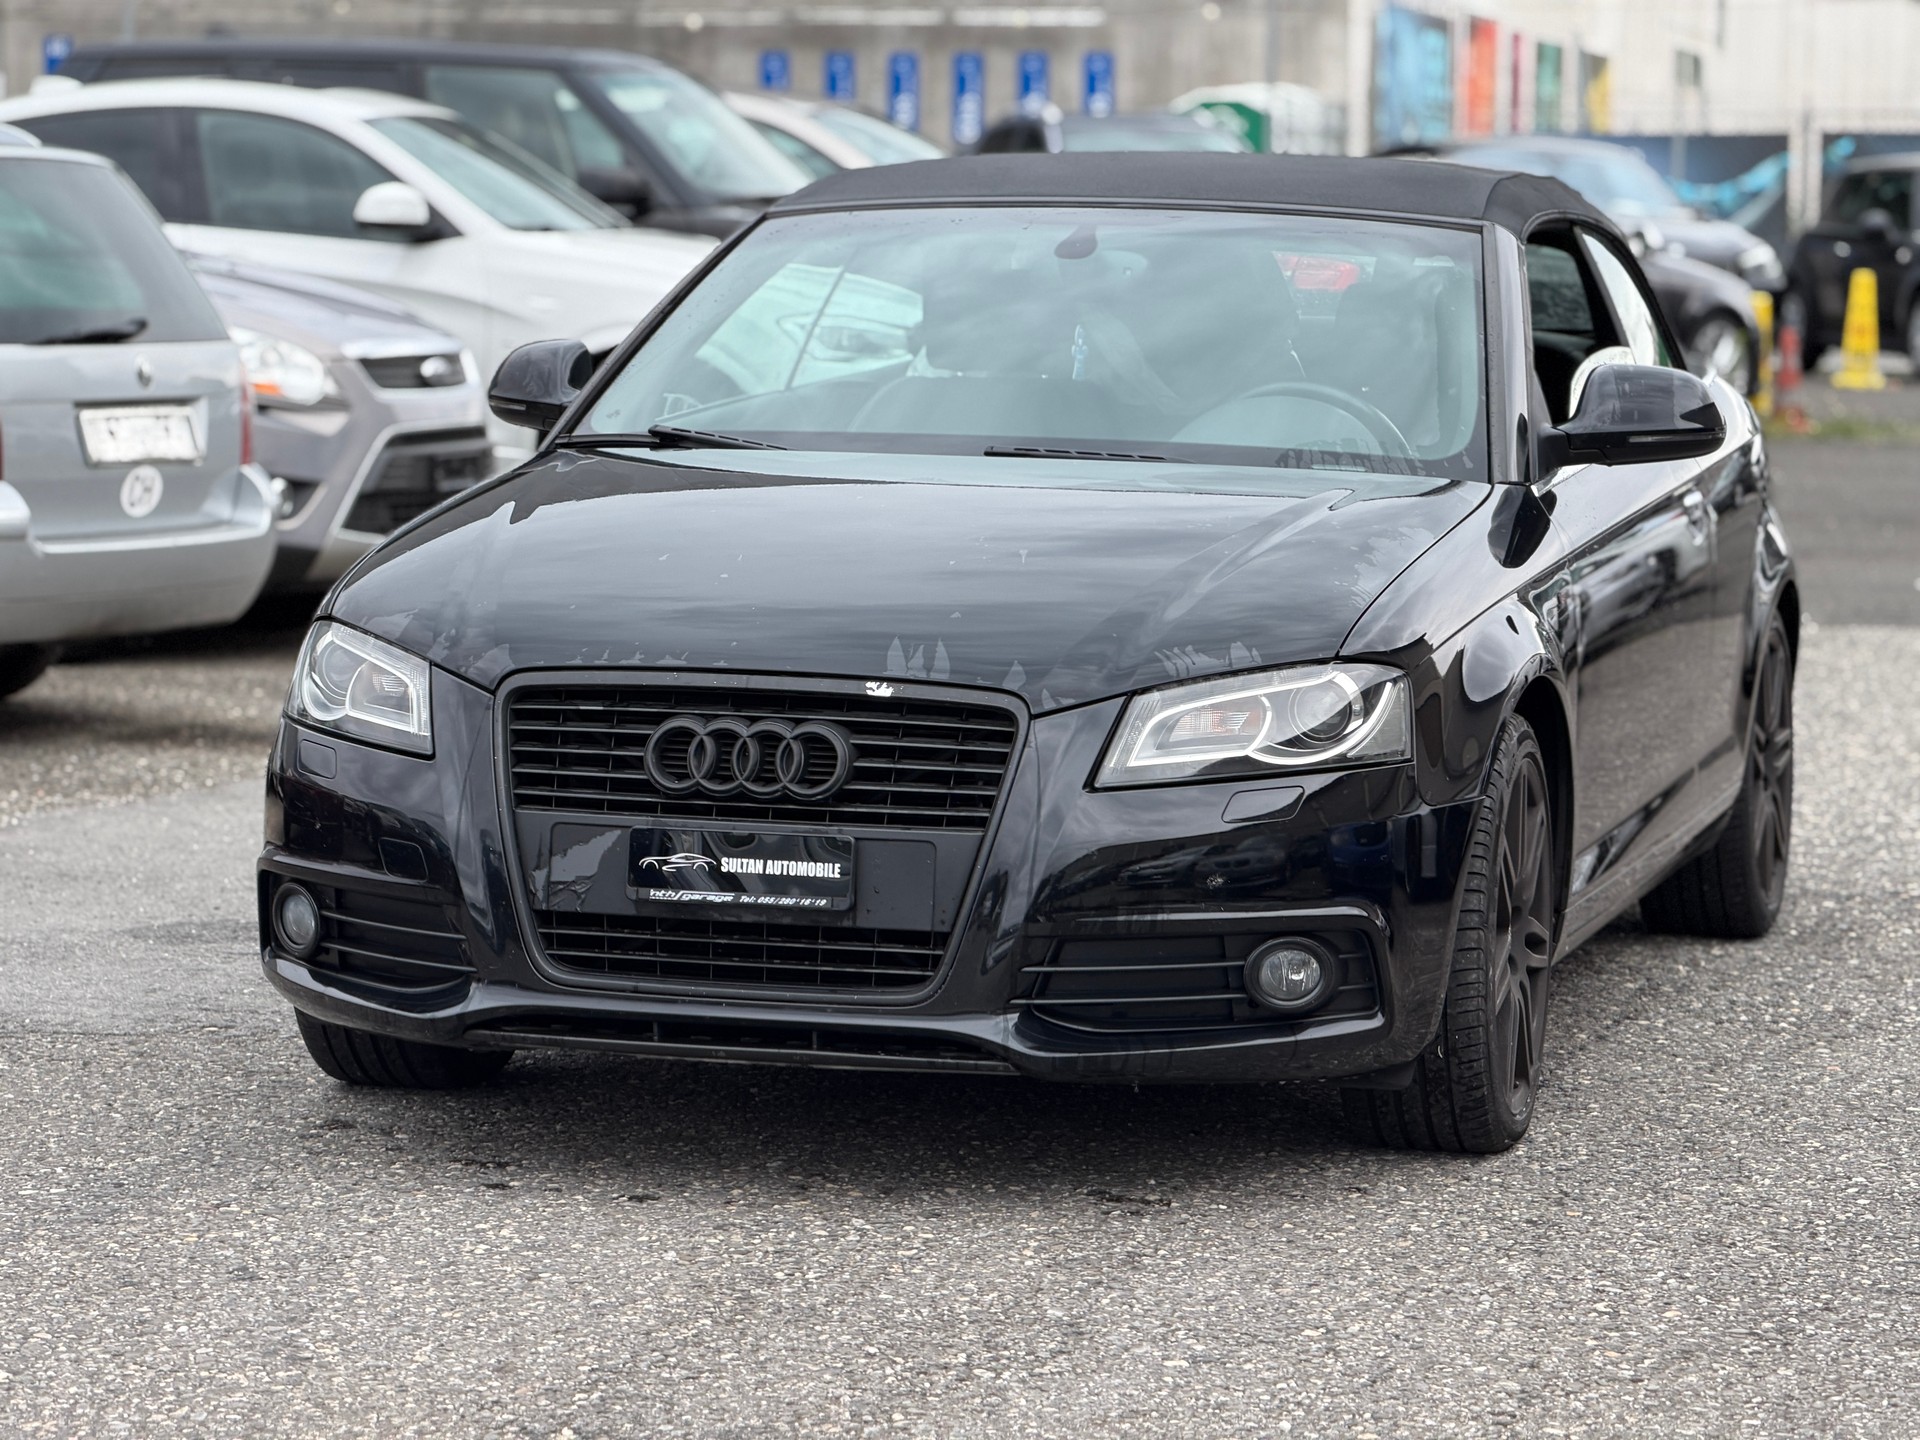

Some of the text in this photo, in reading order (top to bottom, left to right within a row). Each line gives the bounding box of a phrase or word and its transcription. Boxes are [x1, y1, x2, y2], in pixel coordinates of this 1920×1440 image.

[720, 856, 841, 879] SULTAN AUTOMOBILE
[680, 893, 734, 903] garage
